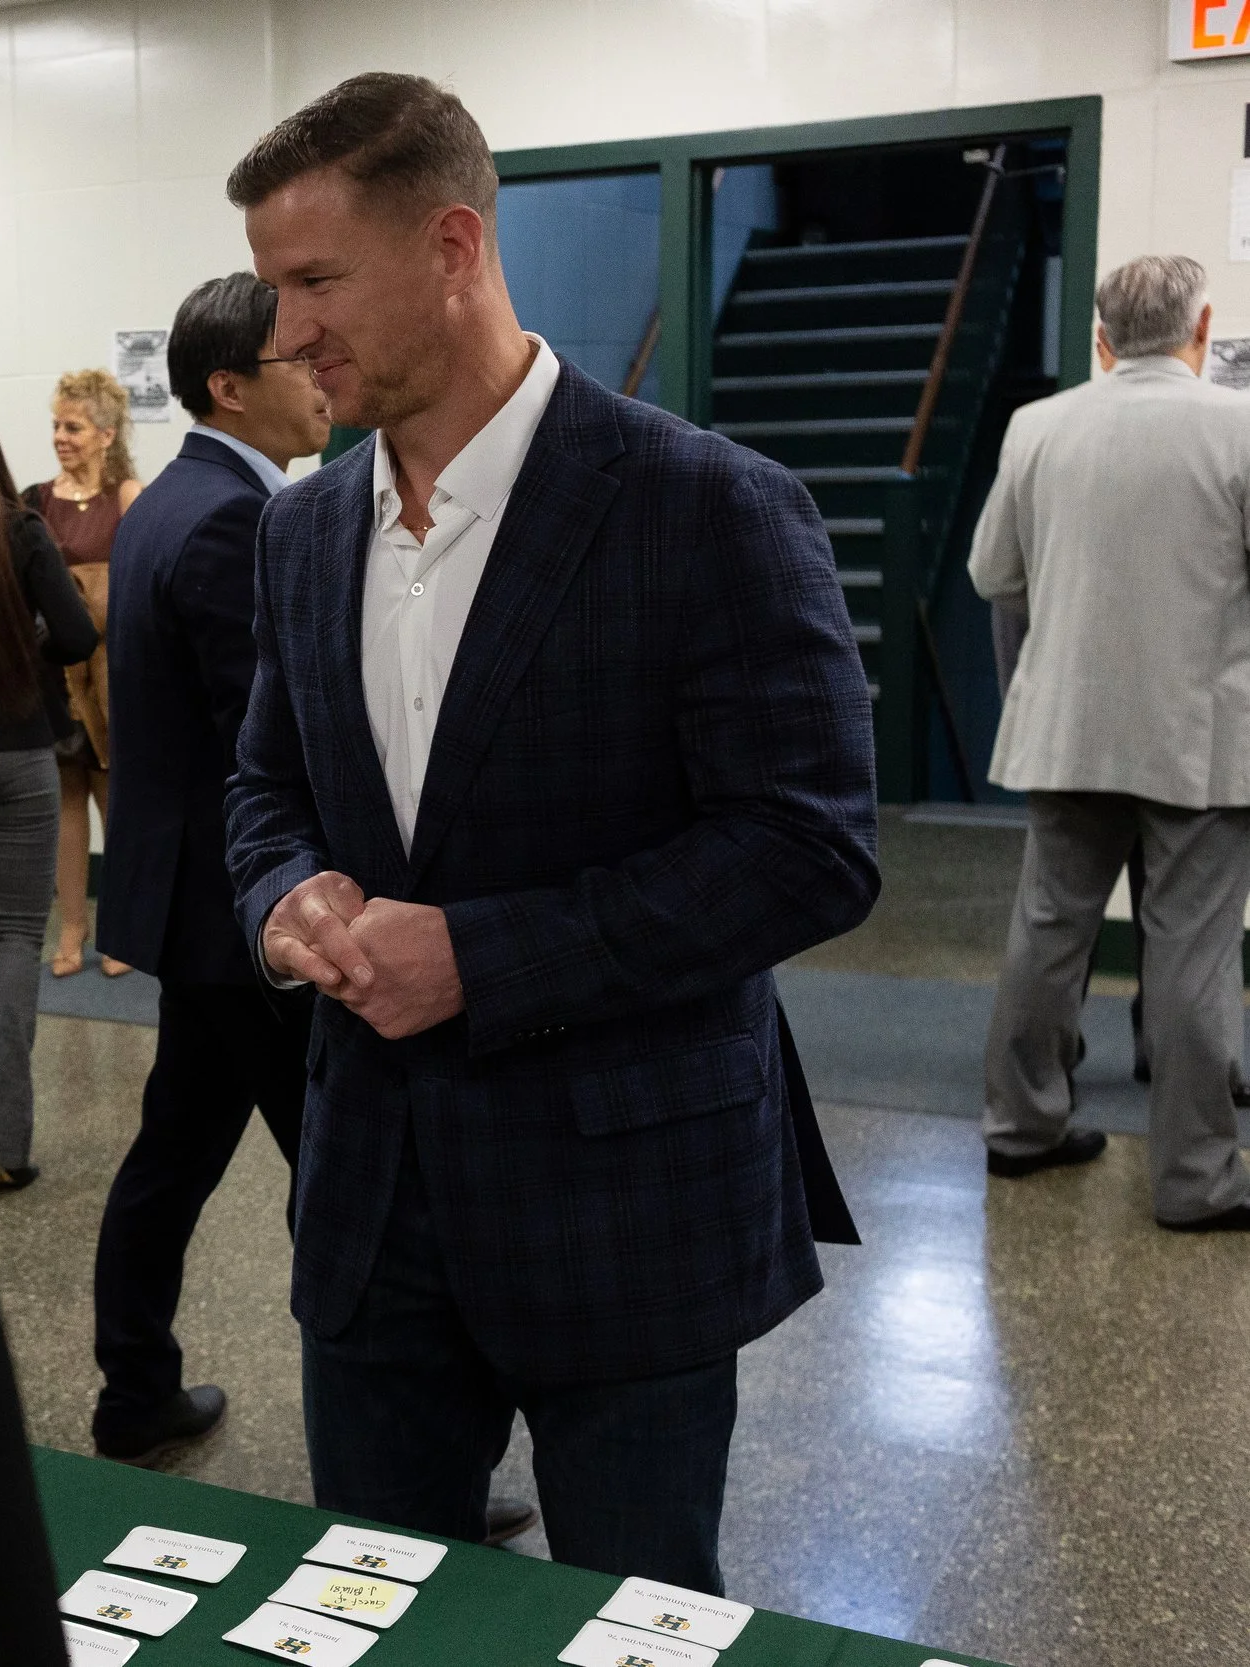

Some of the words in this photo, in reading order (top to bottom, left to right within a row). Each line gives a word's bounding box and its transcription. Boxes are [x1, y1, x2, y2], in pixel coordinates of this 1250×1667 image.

[194, 1545, 225, 1556] Dennis
[358, 1542, 387, 1552] Quinn
[387, 1547, 418, 1559] Jimmy
[109, 1587, 134, 1599] Neary
[334, 1594, 348, 1604] of
[134, 1594, 169, 1607] Michael
[351, 1598, 386, 1609] Guest
[646, 1593, 698, 1612] Schmieder
[698, 1605, 737, 1621] Michael
[291, 1624, 313, 1635] Polla
[313, 1631, 341, 1643] James
[86, 1642, 119, 1657] Tommy
[620, 1637, 654, 1650] Savino
[655, 1645, 693, 1660] William
